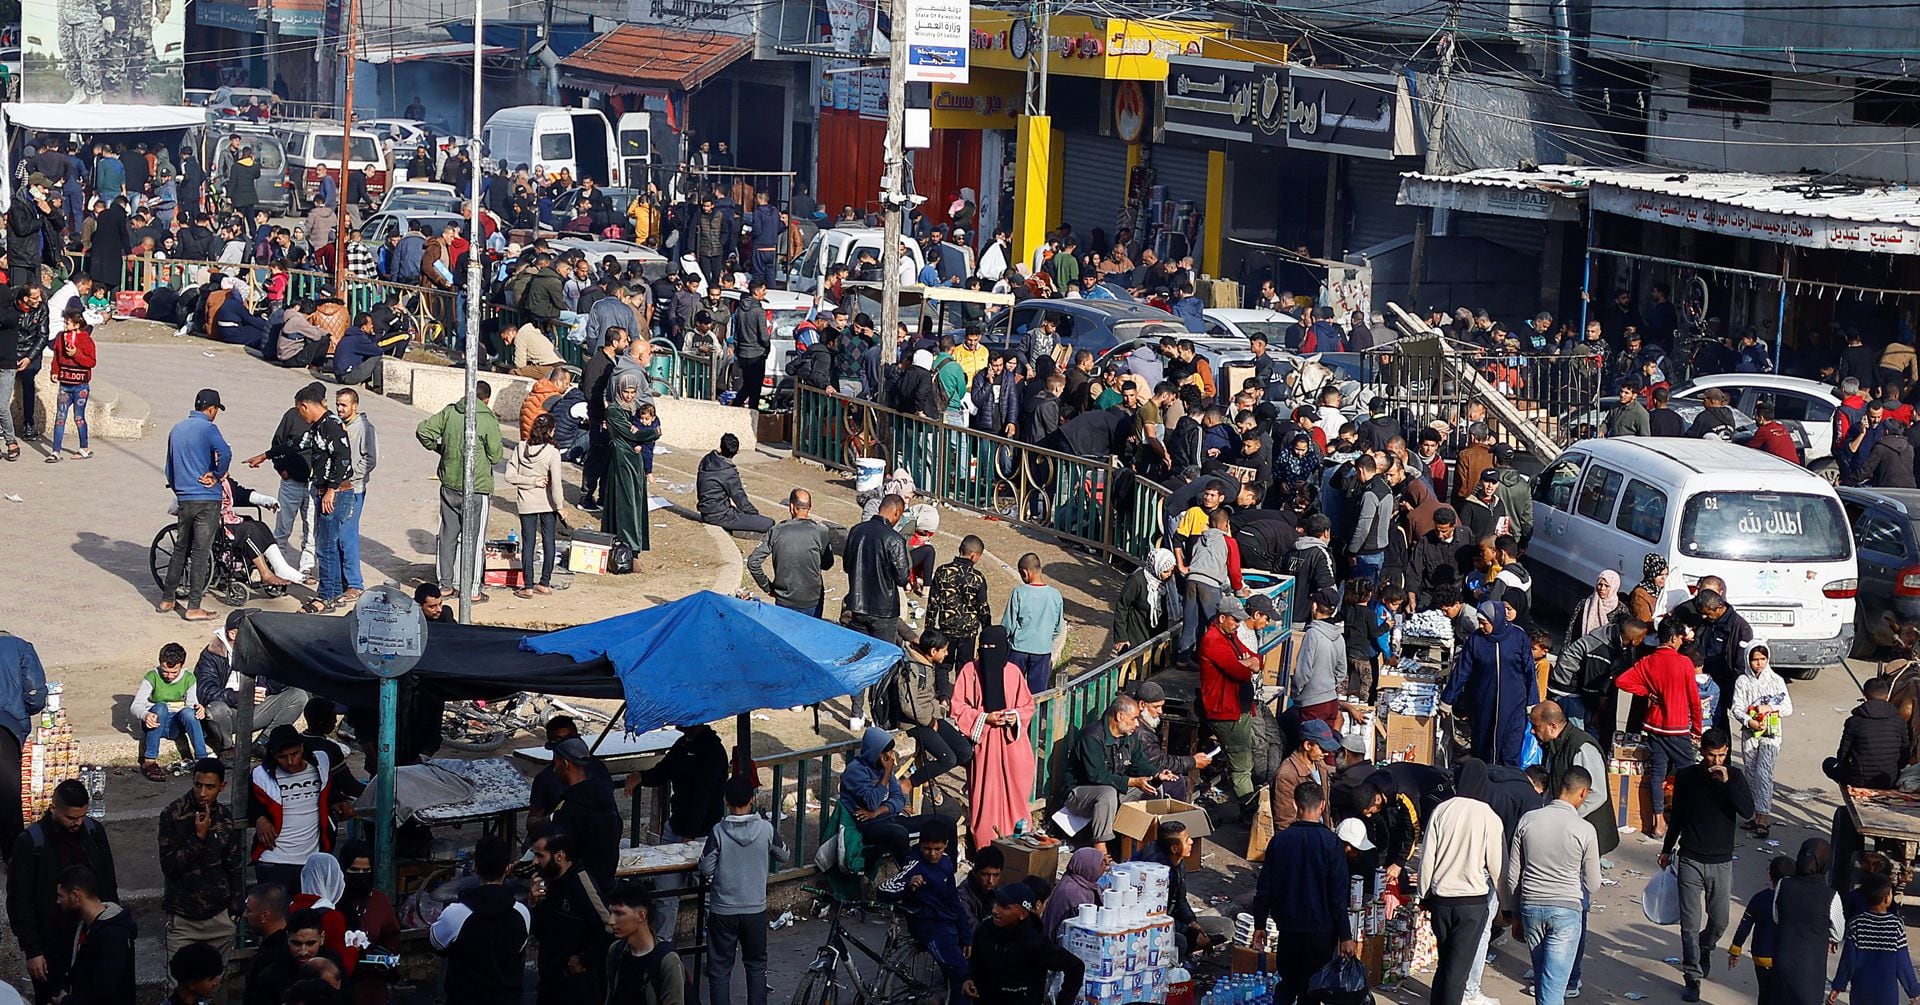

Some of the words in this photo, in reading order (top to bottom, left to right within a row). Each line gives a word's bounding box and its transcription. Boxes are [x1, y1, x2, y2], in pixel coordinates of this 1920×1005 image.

[915, 20, 944, 31] العمل
[945, 22, 961, 33] وزارة
[1686, 208, 1698, 223] بيع
[1830, 226, 1860, 245] تبديل
[1704, 497, 1719, 510] 01
[1738, 509, 1762, 534] لله
[1765, 510, 1803, 535] الملك
